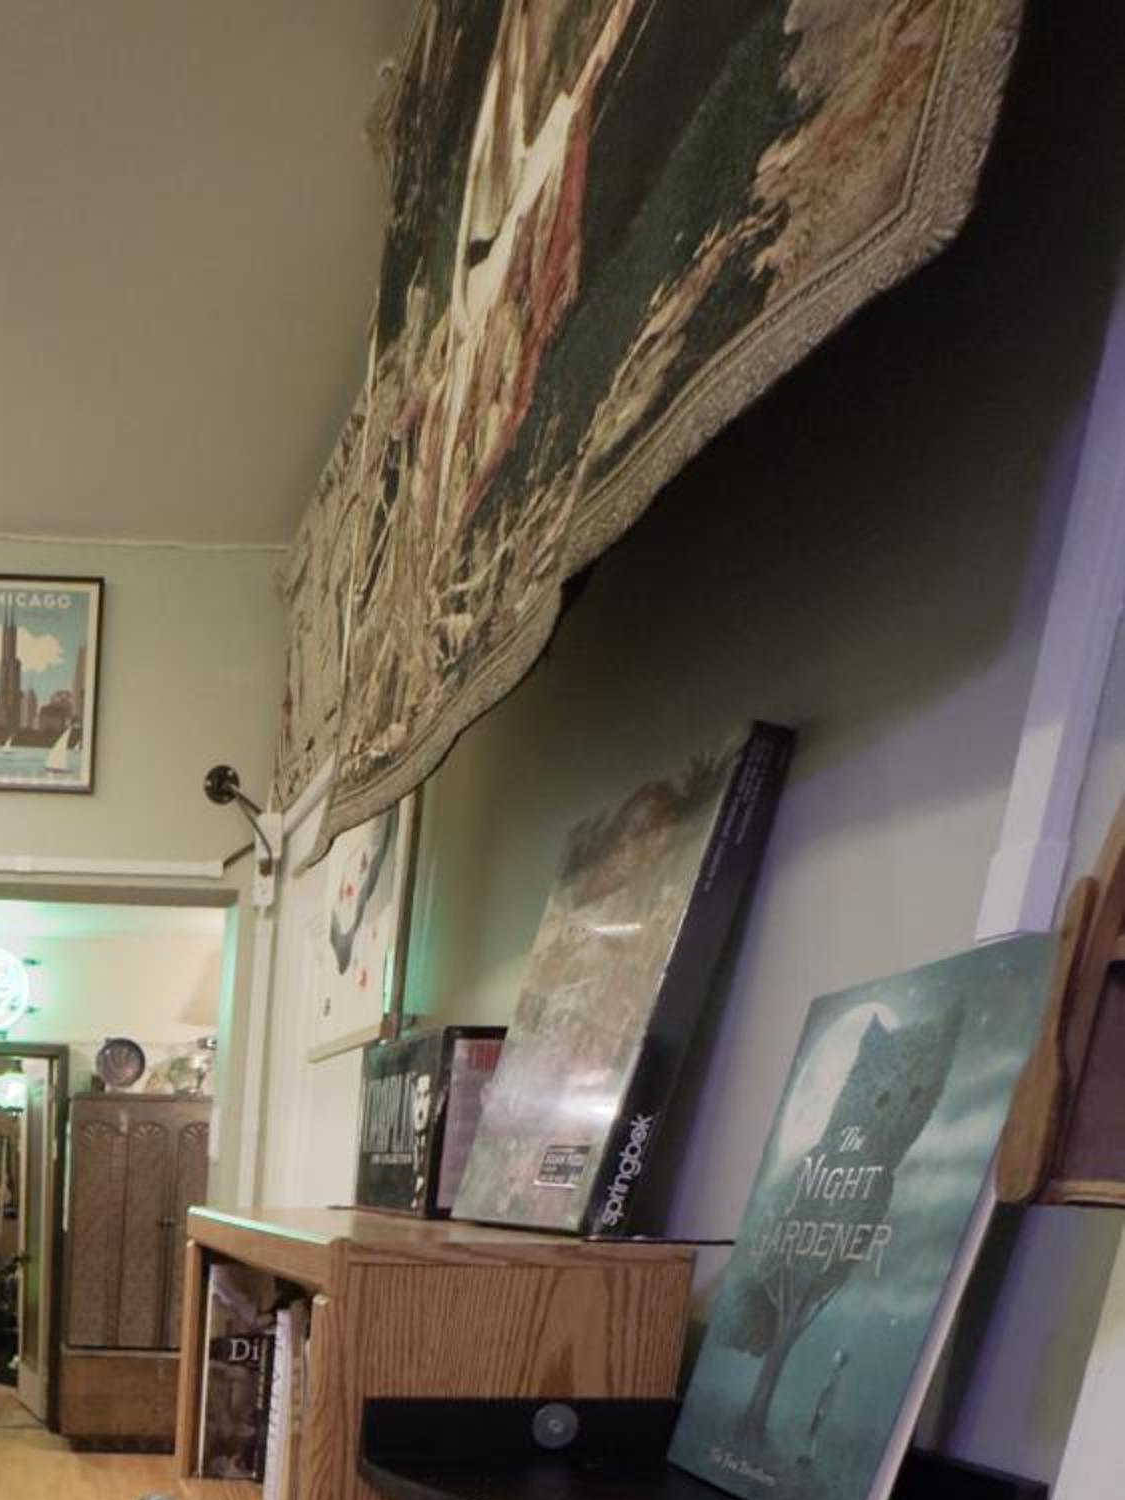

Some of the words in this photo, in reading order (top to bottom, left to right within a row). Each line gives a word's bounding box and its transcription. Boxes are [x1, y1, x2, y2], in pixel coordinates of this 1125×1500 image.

[838, 1125, 866, 1153] The
[602, 1113, 653, 1226] springbok
[749, 1219, 892, 1278] GARDENER
